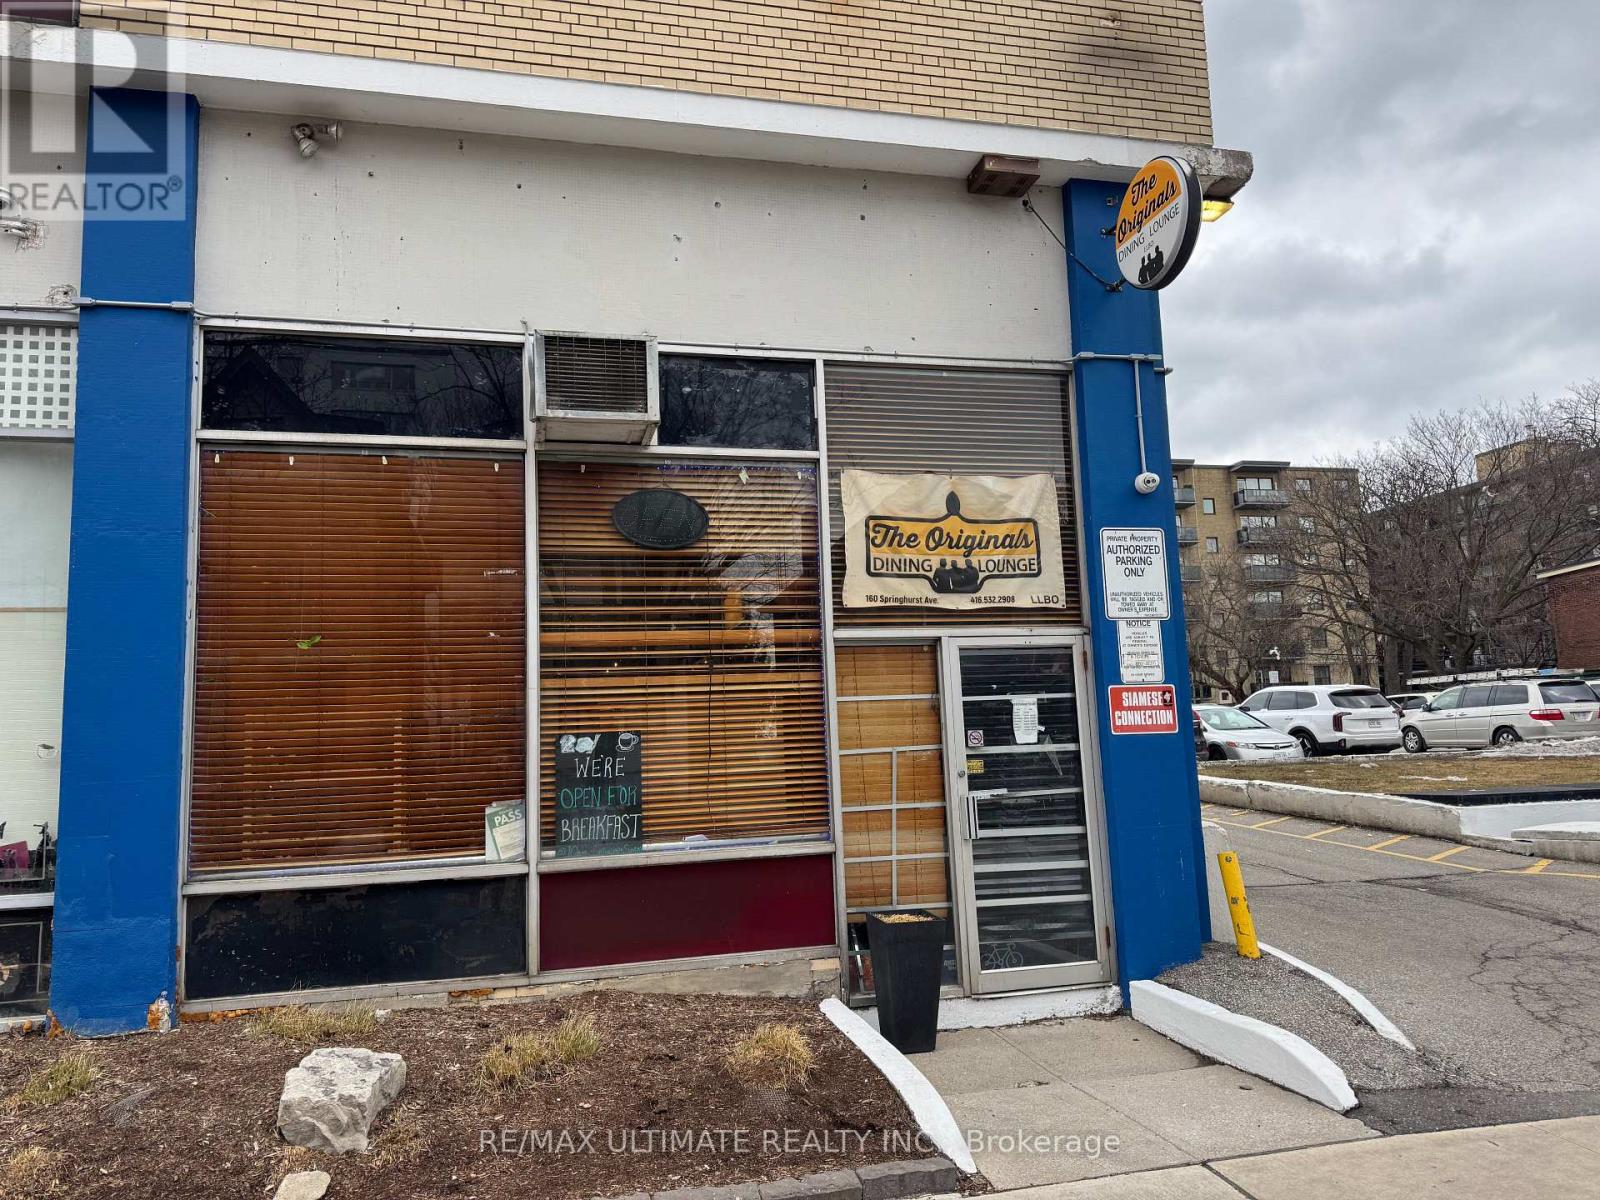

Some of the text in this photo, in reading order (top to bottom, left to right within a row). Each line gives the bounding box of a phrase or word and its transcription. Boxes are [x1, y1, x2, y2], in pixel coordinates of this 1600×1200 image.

[1131, 173, 1157, 206] The
[1117, 180, 1177, 243] Originals
[1118, 202, 1180, 263] DINING LOUNGE
[870, 523, 1033, 558] The Originals
[1106, 544, 1160, 555] AUTHORIZED
[873, 557, 1037, 573] DINING LOUNGE
[1115, 555, 1153, 566] PARKING
[1124, 567, 1145, 578] ONLY
[865, 595, 878, 603] 160
[879, 594, 923, 605] Springhurst
[1030, 595, 1059, 605] LLBO
[1122, 691, 1163, 706] SIAMESE
[1115, 710, 1173, 726] CONNECTION
[574, 755, 626, 778] WE'RE
[560, 785, 638, 809] OPEN FOR
[494, 809, 522, 827] PASS
[561, 814, 642, 842] BREAKFAST
